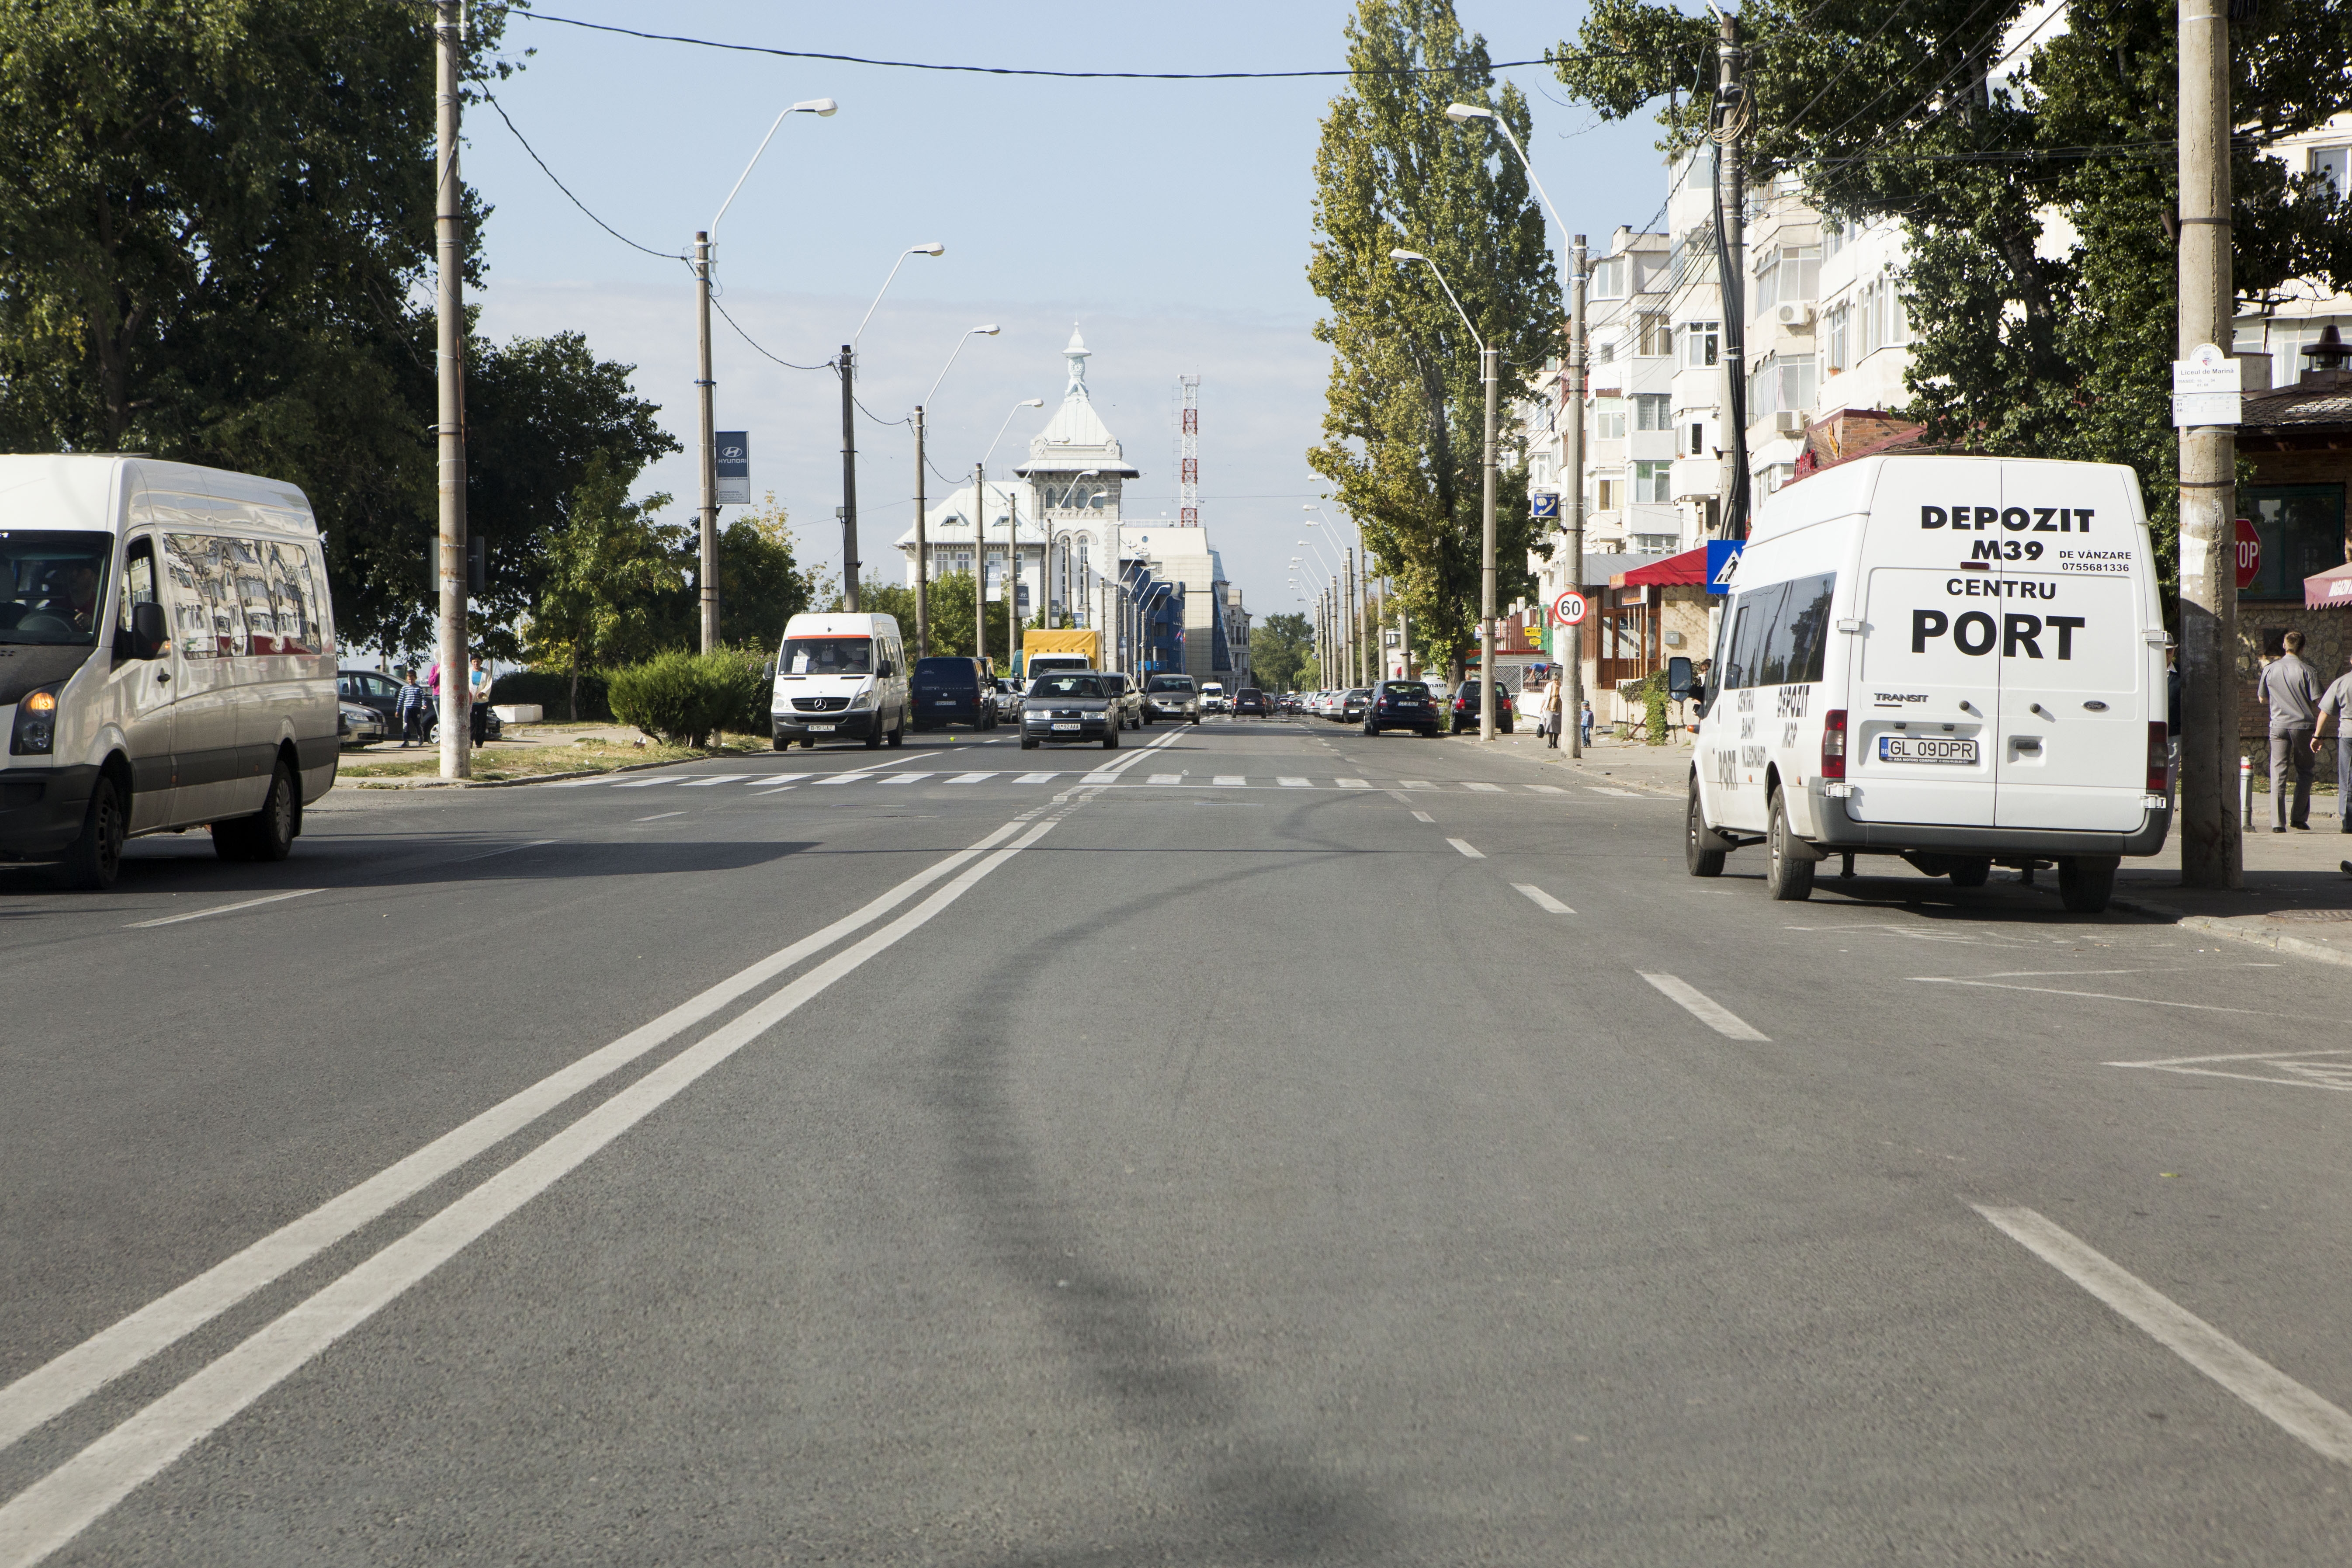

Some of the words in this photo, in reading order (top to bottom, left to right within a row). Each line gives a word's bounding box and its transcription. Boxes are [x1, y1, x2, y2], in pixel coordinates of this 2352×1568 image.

[1922, 506, 2095, 533] DEPOZIT
[1971, 540, 2044, 561] M39
[2059, 550, 2073, 559] DE
[2078, 549, 2132, 560] VÂNZARE
[2062, 562, 2129, 572] 0755681336
[1946, 578, 2057, 600] CENTRU
[1561, 600, 1581, 616] 60
[1911, 609, 2085, 660] PORT
[1738, 690, 1755, 712] CENTRU
[1777, 685, 1810, 718] DEPOZIT
[1874, 693, 1929, 702] TRANSIT
[1890, 741, 1911, 755] GL
[1718, 750, 1738, 791] PORT
